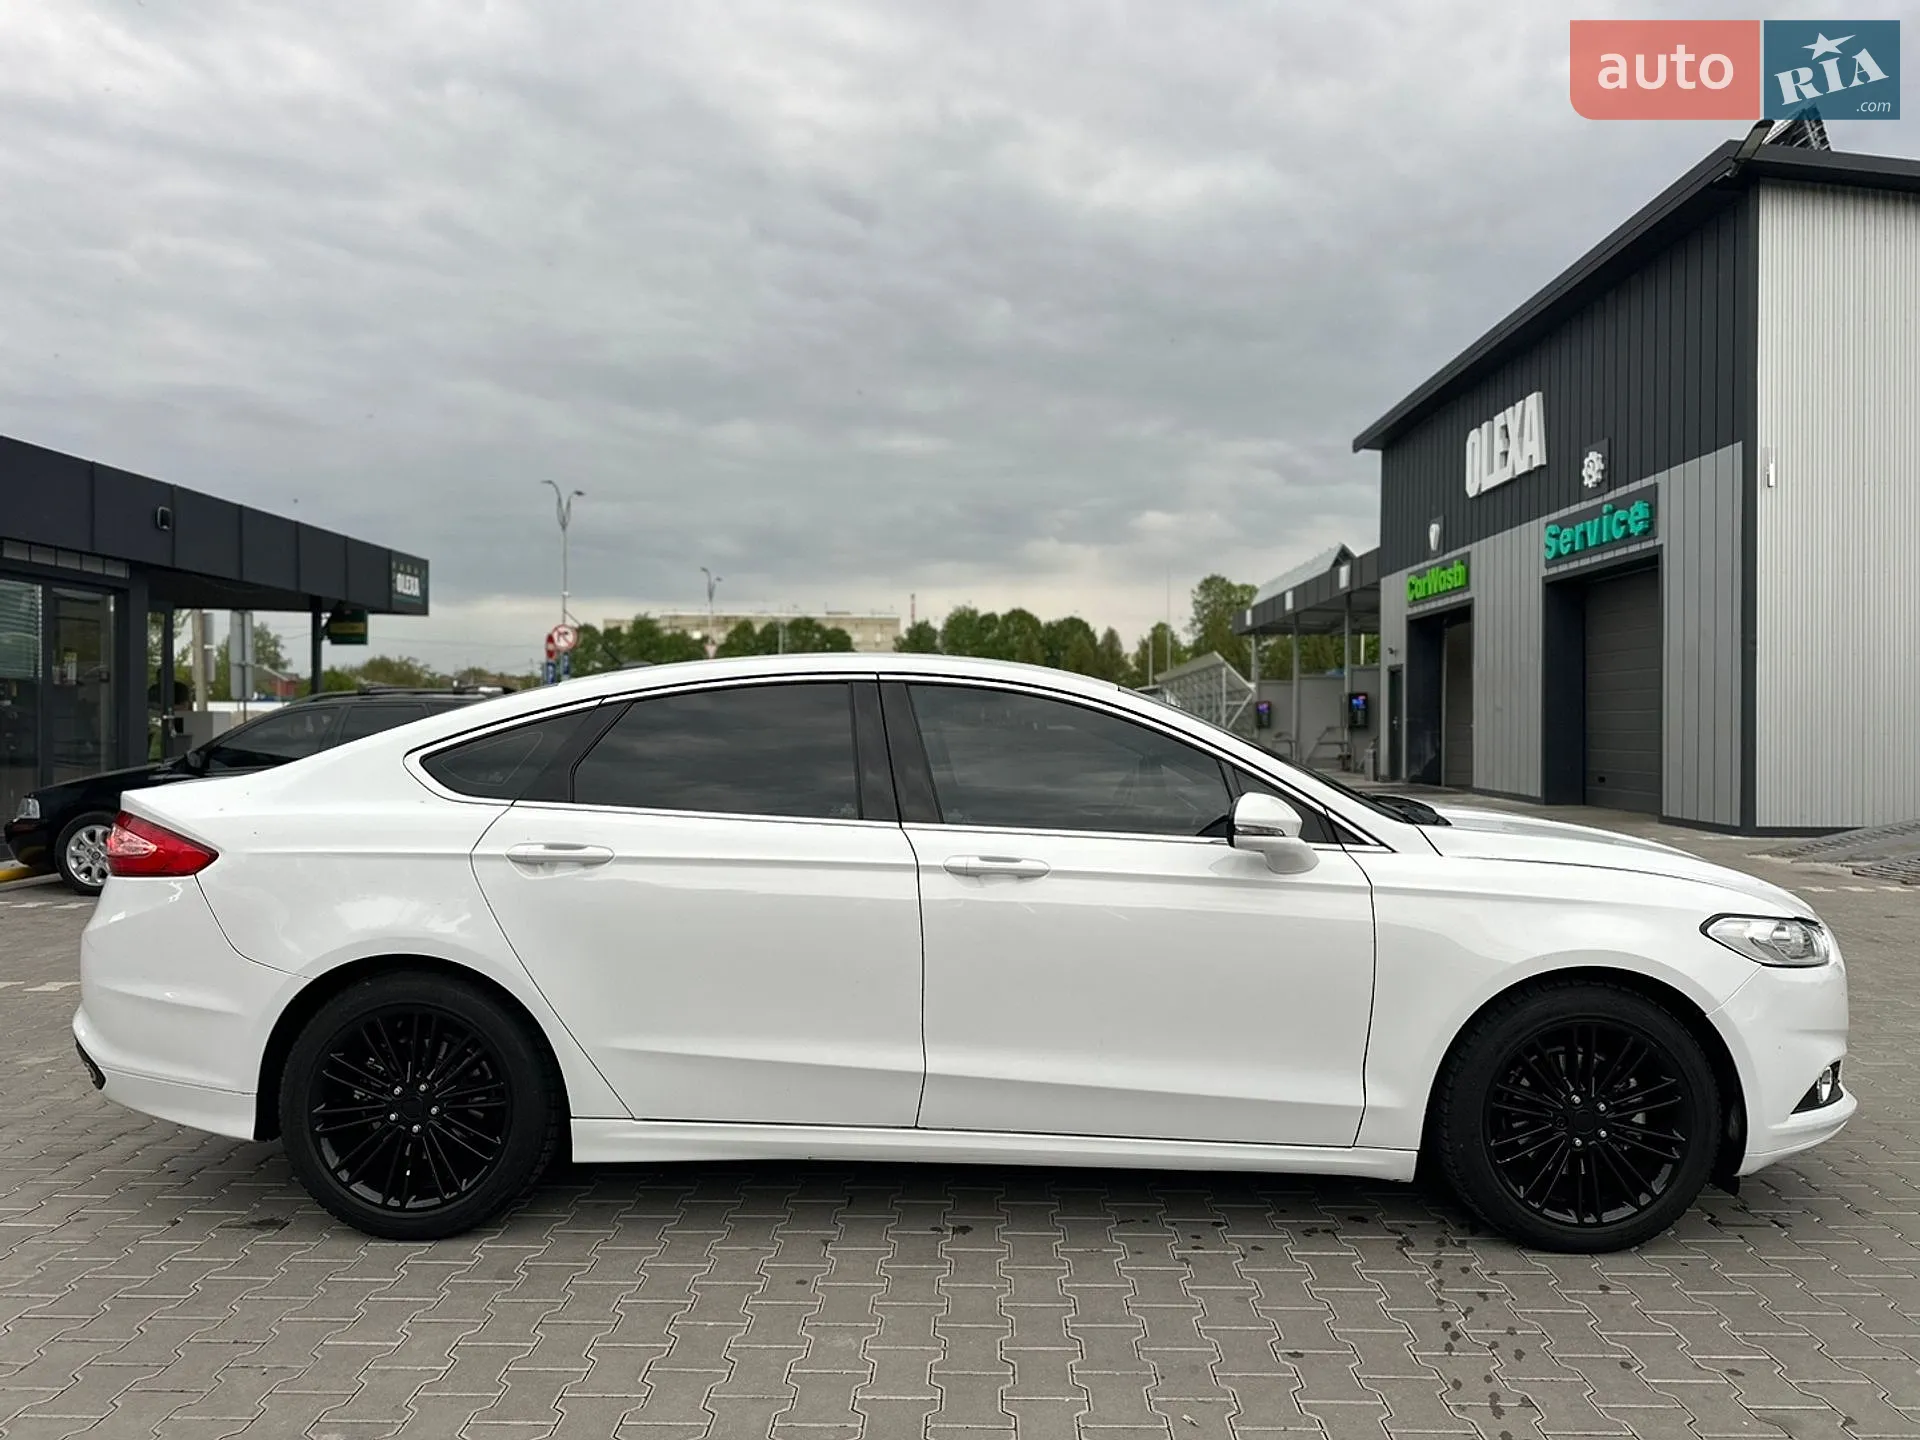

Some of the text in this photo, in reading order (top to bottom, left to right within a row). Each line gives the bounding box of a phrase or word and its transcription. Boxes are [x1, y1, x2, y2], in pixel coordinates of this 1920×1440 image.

[1465, 391, 1547, 498] OLEXA
[1544, 500, 1652, 559] Service
[1407, 560, 1468, 601] CarWash
